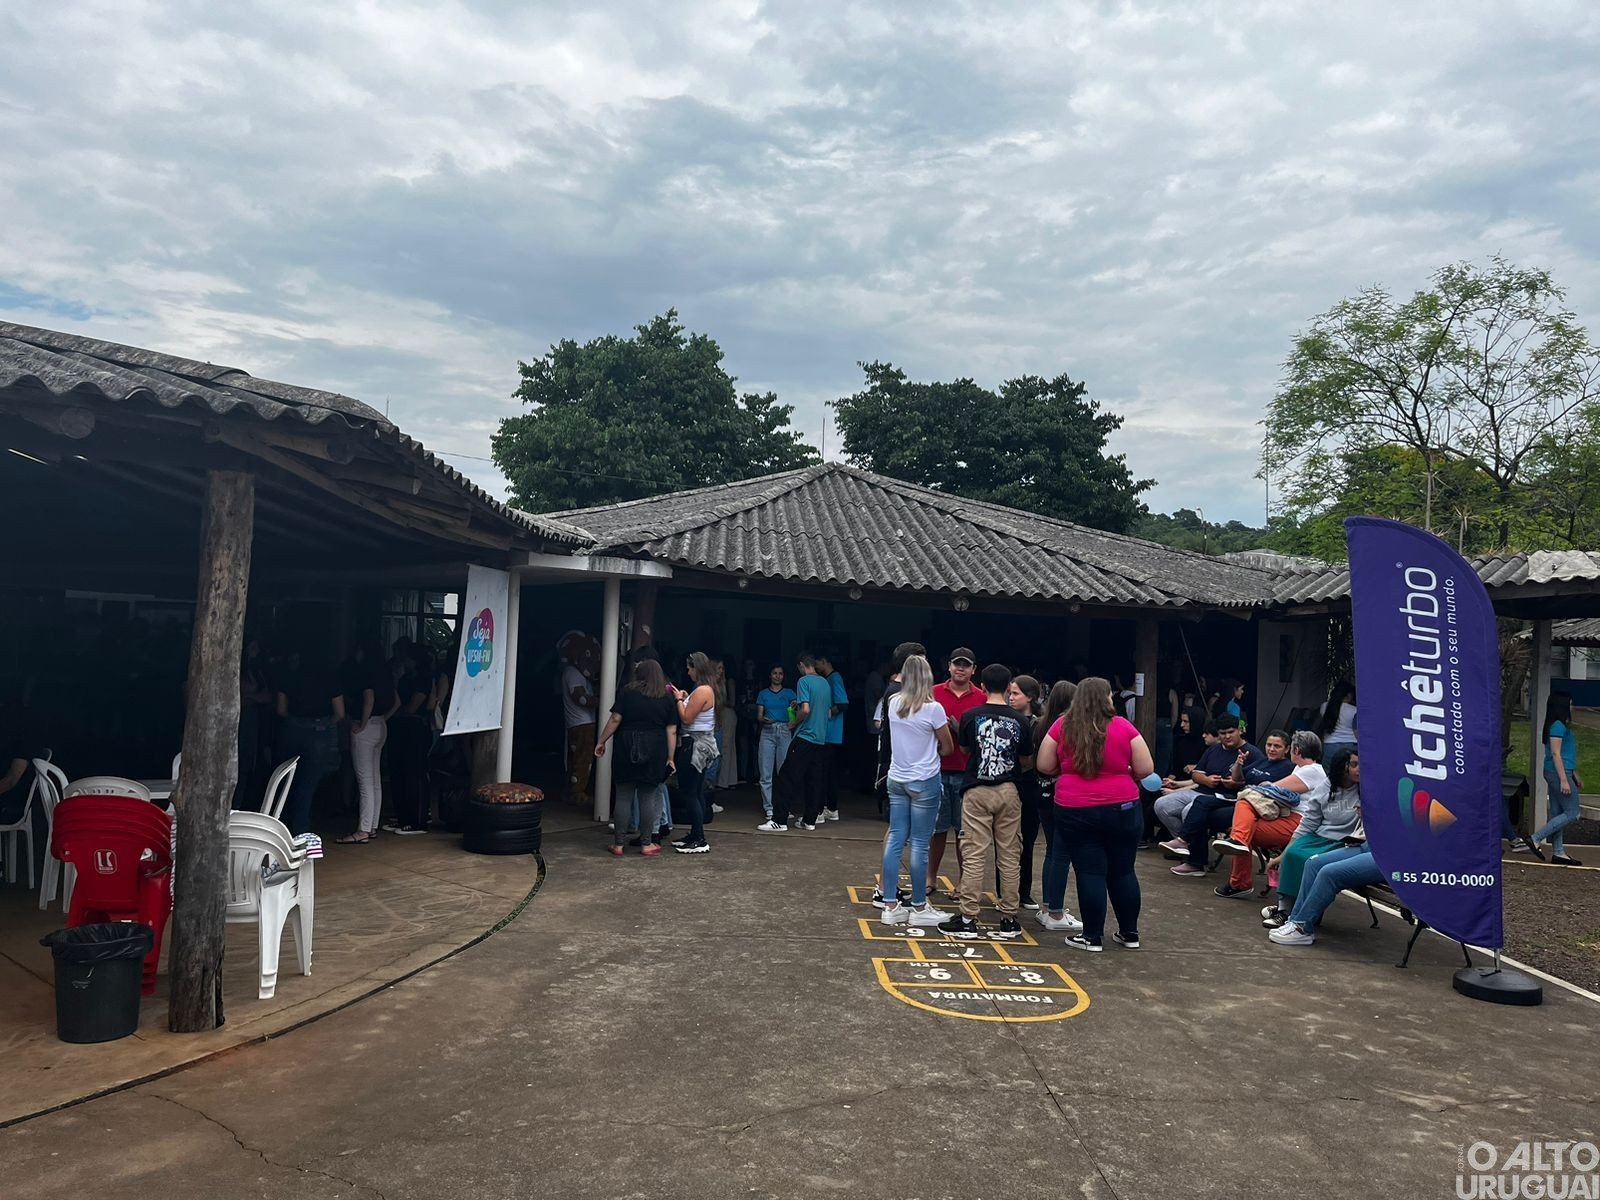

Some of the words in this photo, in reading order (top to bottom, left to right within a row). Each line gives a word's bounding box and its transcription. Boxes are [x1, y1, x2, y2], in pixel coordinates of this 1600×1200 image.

[1443, 576, 1456, 624] mundo.
[473, 618, 490, 647] Seja
[1447, 629, 1458, 652] seu
[1399, 566, 1448, 781] tchêturbo
[1449, 657, 1459, 665] o
[1449, 670, 1461, 697] com
[1451, 702, 1465, 775] conectada
[1403, 872, 1417, 883] 55
[1421, 872, 1494, 886] 2010-0000
[928, 991, 1053, 1004] FORMATURA
